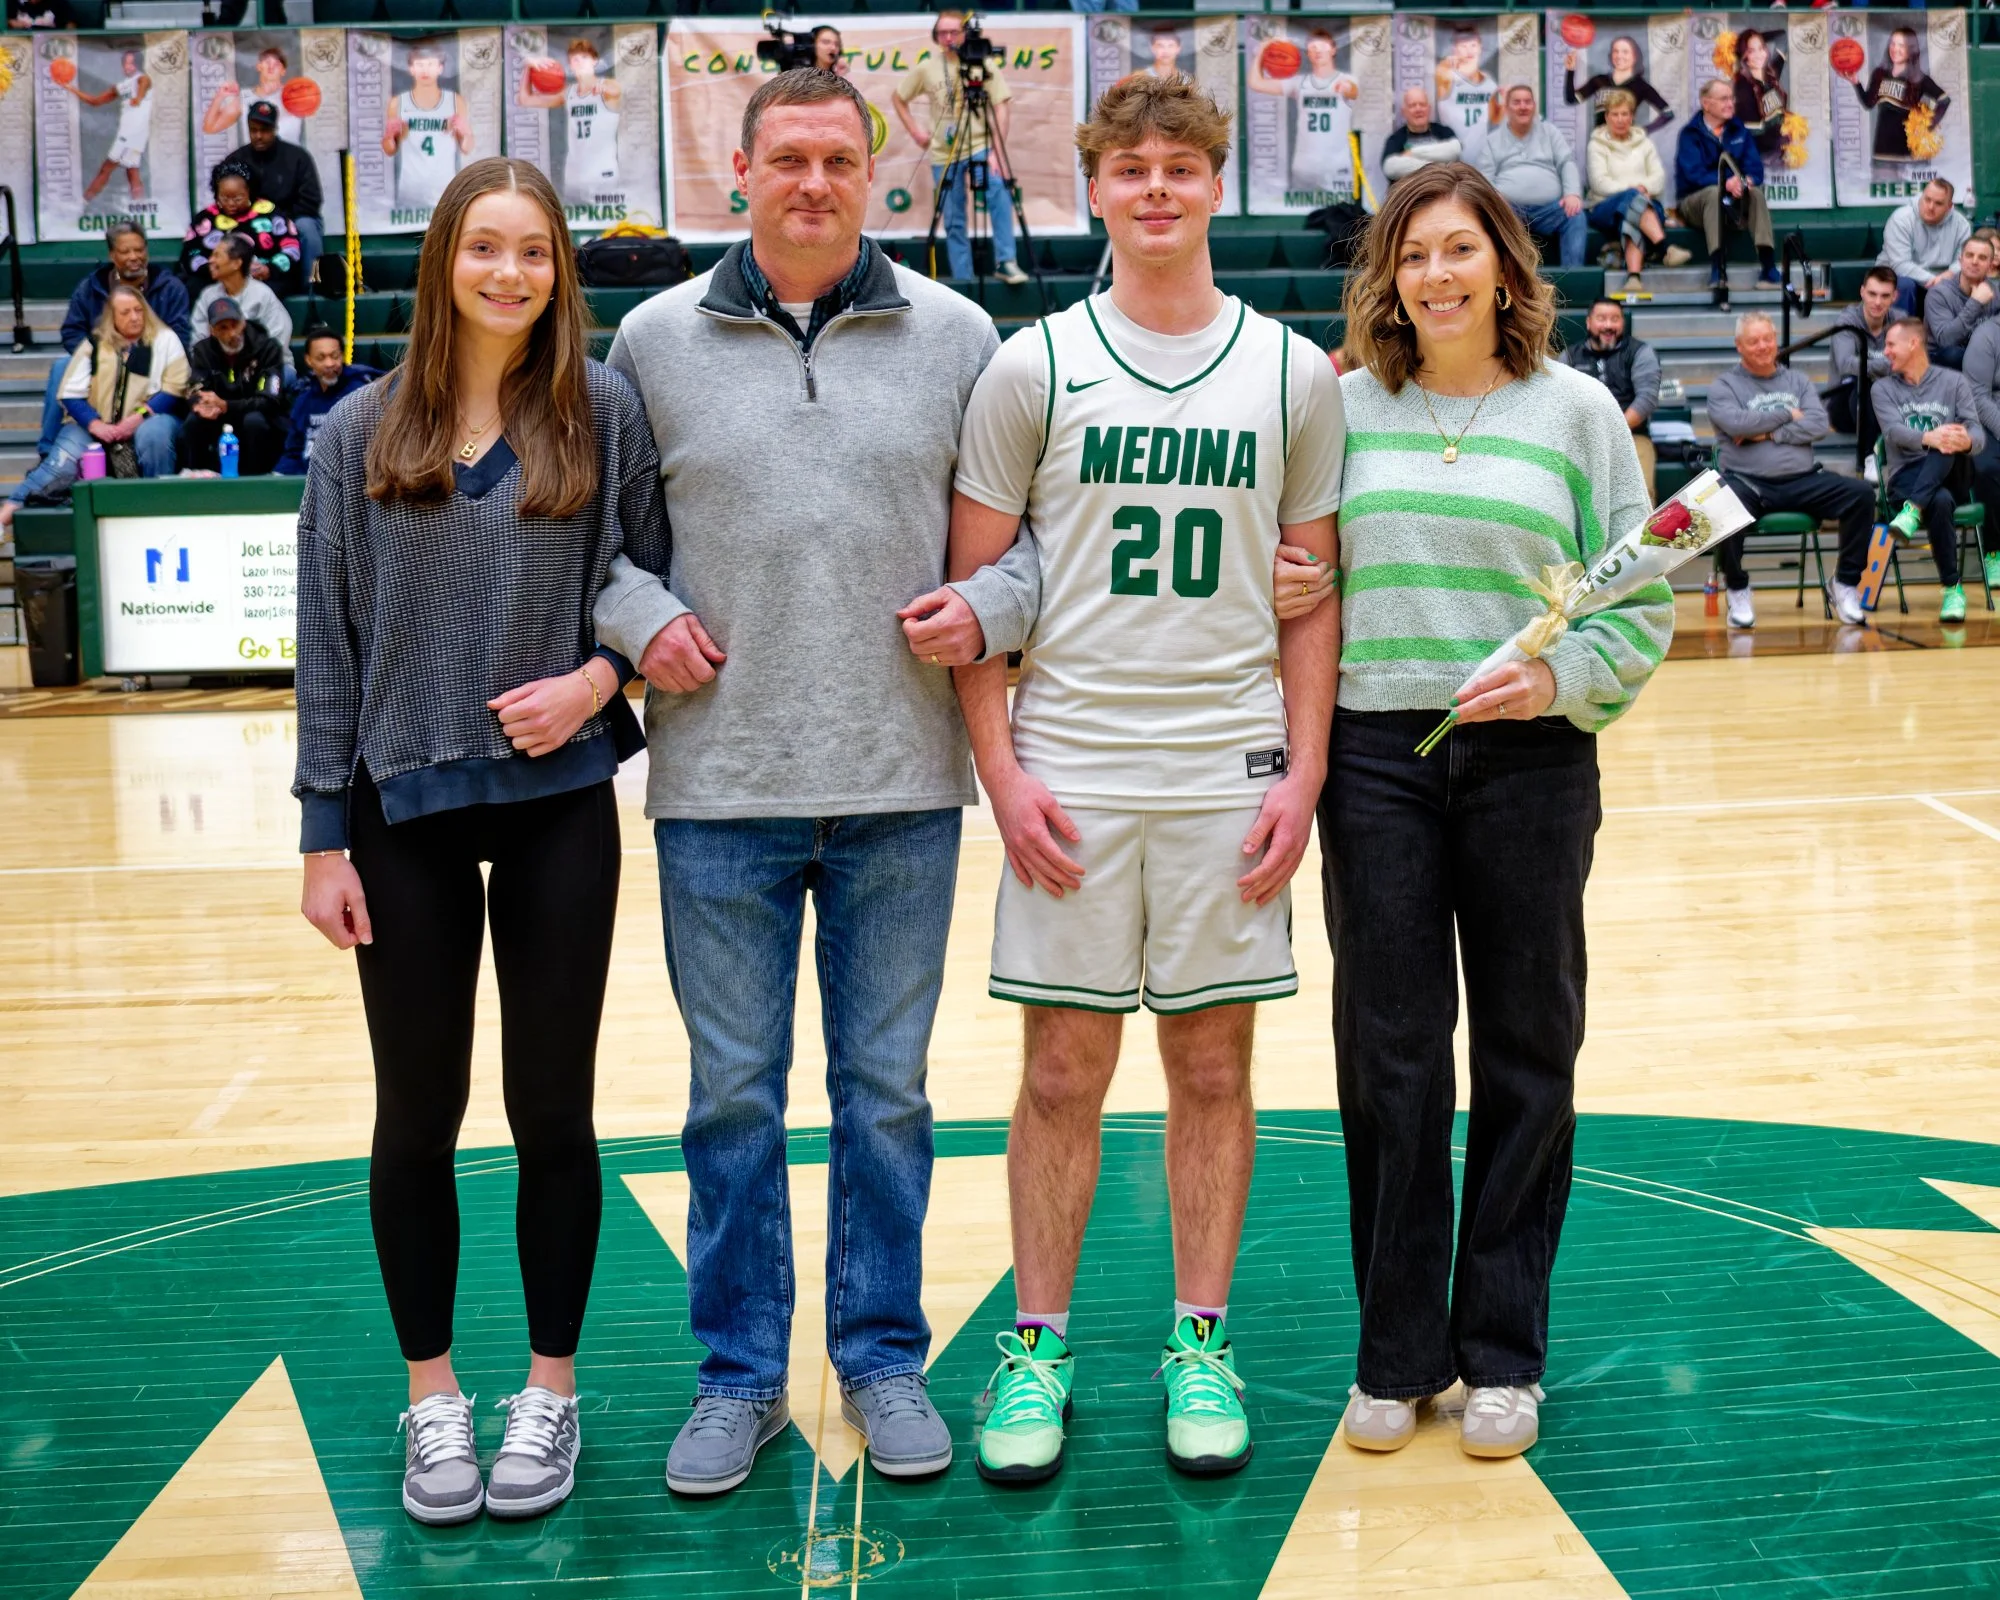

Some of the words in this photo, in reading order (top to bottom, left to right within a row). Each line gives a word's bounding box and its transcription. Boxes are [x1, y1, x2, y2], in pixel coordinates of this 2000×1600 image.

[356, 60, 382, 109] BEES
[408, 118, 448, 131] MEDINA
[1307, 112, 1331, 132] 20
[421, 136, 435, 156] 4
[1251, 100, 1277, 177] MEDINA
[358, 117, 385, 196] MEDINA
[1911, 171, 1938, 181] AVERY
[1332, 180, 1354, 191] TYLE
[1766, 186, 1799, 201] ARD
[594, 194, 626, 204] BRODY
[1283, 191, 1354, 207] MINARC
[563, 203, 628, 221] OPKAS
[1080, 426, 1257, 490] MEDINA
[241, 541, 264, 557] Joe
[1110, 505, 1223, 598] 20
[242, 565, 269, 578] Lazor
[272, 564, 298, 577] Insur
[243, 585, 297, 598] 330-722-4
[121, 601, 215, 616] Nationwide
[238, 636, 271, 659] Go
[277, 637, 298, 659] B
[1275, 755, 1282, 767] M
